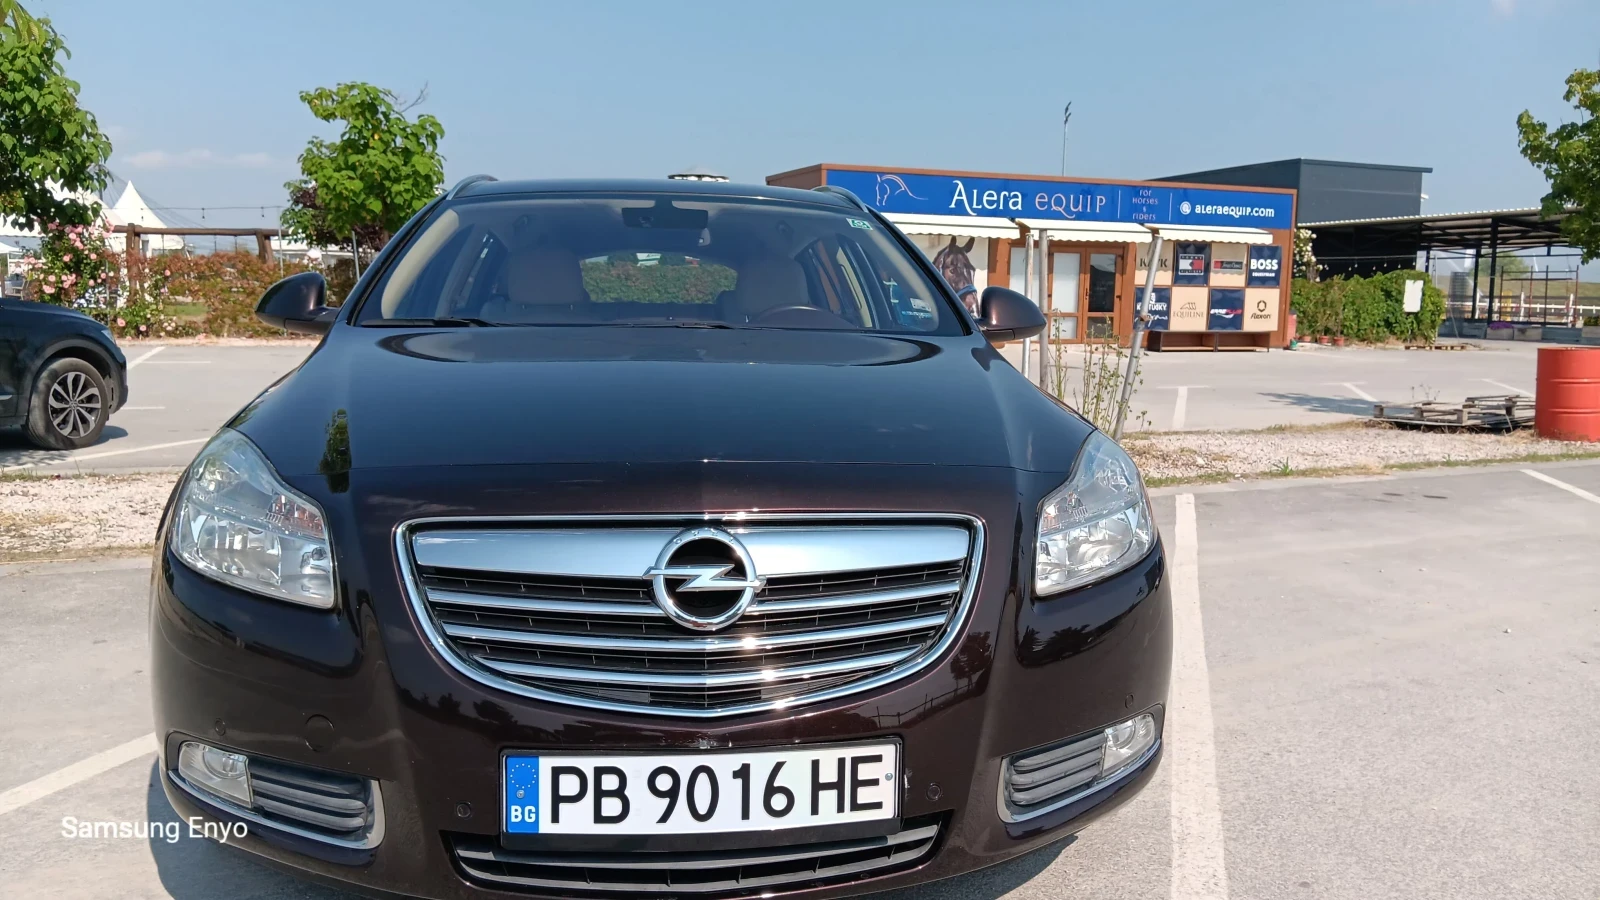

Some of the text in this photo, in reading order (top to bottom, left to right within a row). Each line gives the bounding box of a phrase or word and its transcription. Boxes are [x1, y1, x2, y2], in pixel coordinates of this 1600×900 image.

[1250, 258, 1278, 270] BOSS
[550, 754, 883, 824] PB 9016 HE
[510, 805, 536, 823] BG
